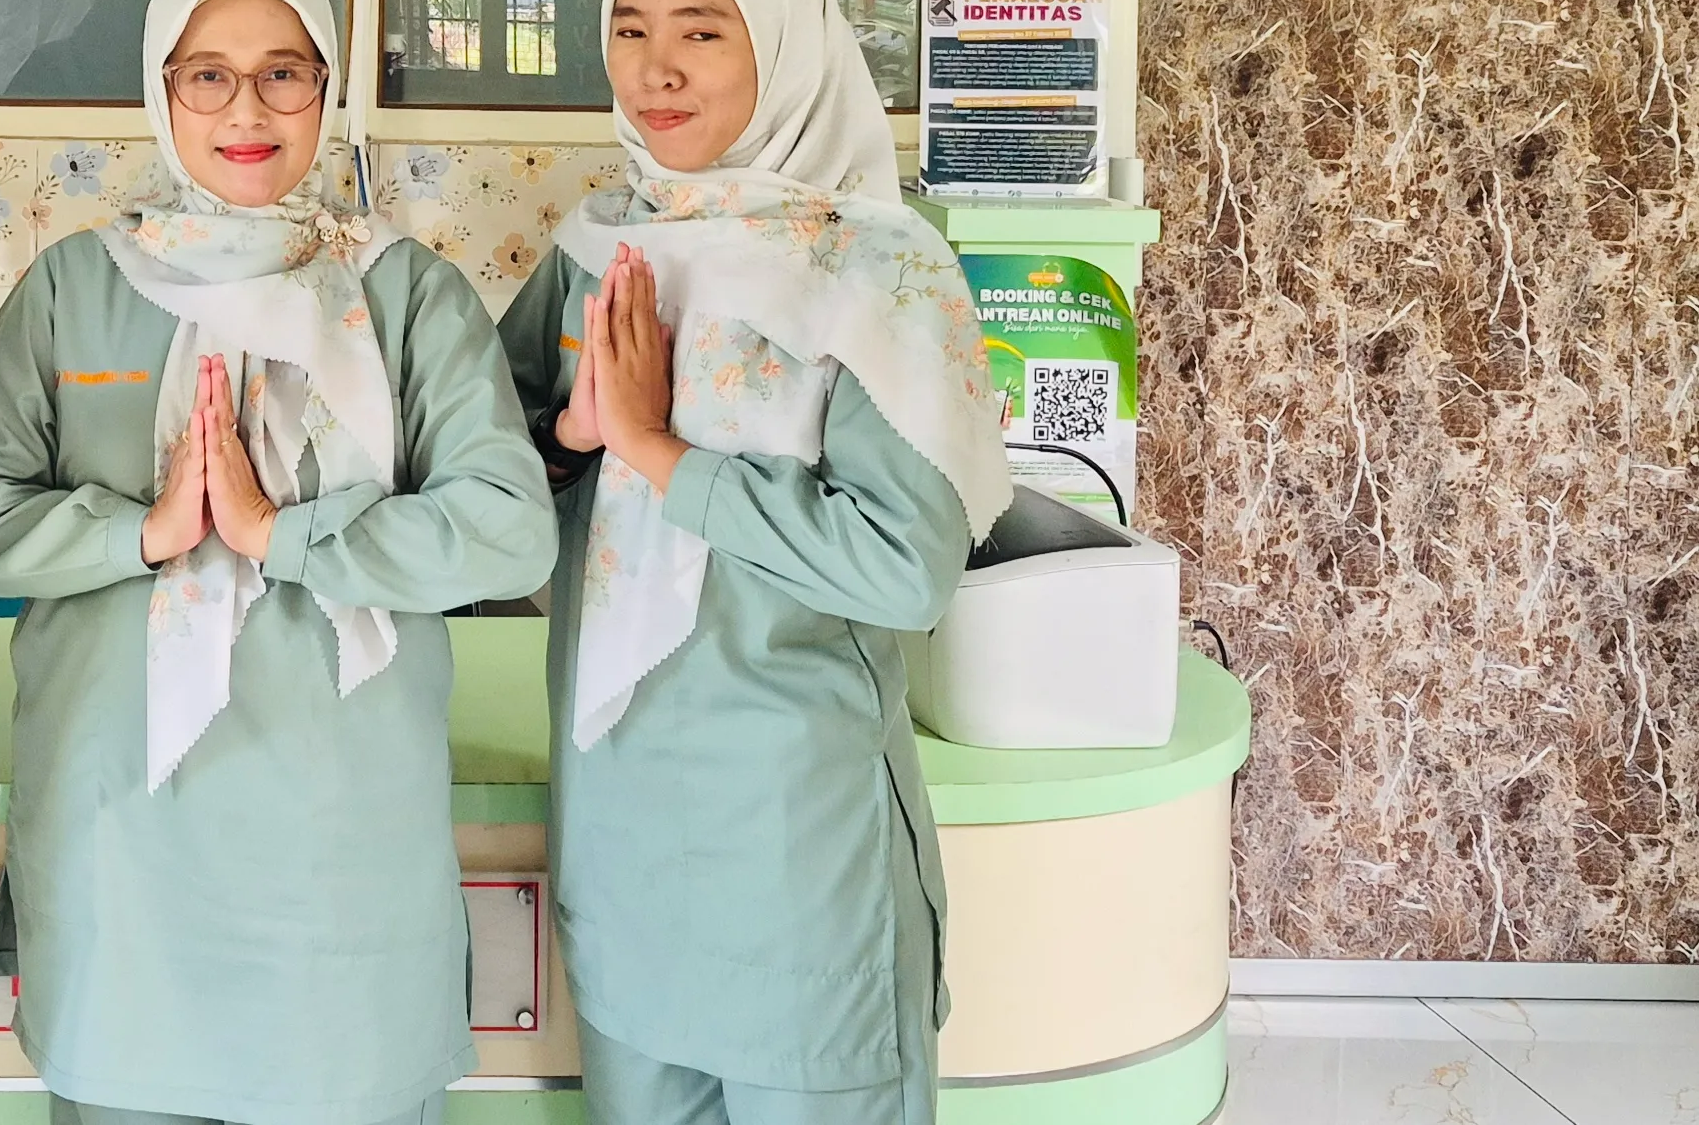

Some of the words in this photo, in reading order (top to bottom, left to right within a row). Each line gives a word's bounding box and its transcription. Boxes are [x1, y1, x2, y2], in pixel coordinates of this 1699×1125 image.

[963, 5, 1083, 21] IDENTITAS
[979, 288, 1057, 304] BOOKING
[1059, 290, 1075, 304] &
[1078, 292, 1112, 311] CEK
[1056, 308, 1122, 331] ONLINE
